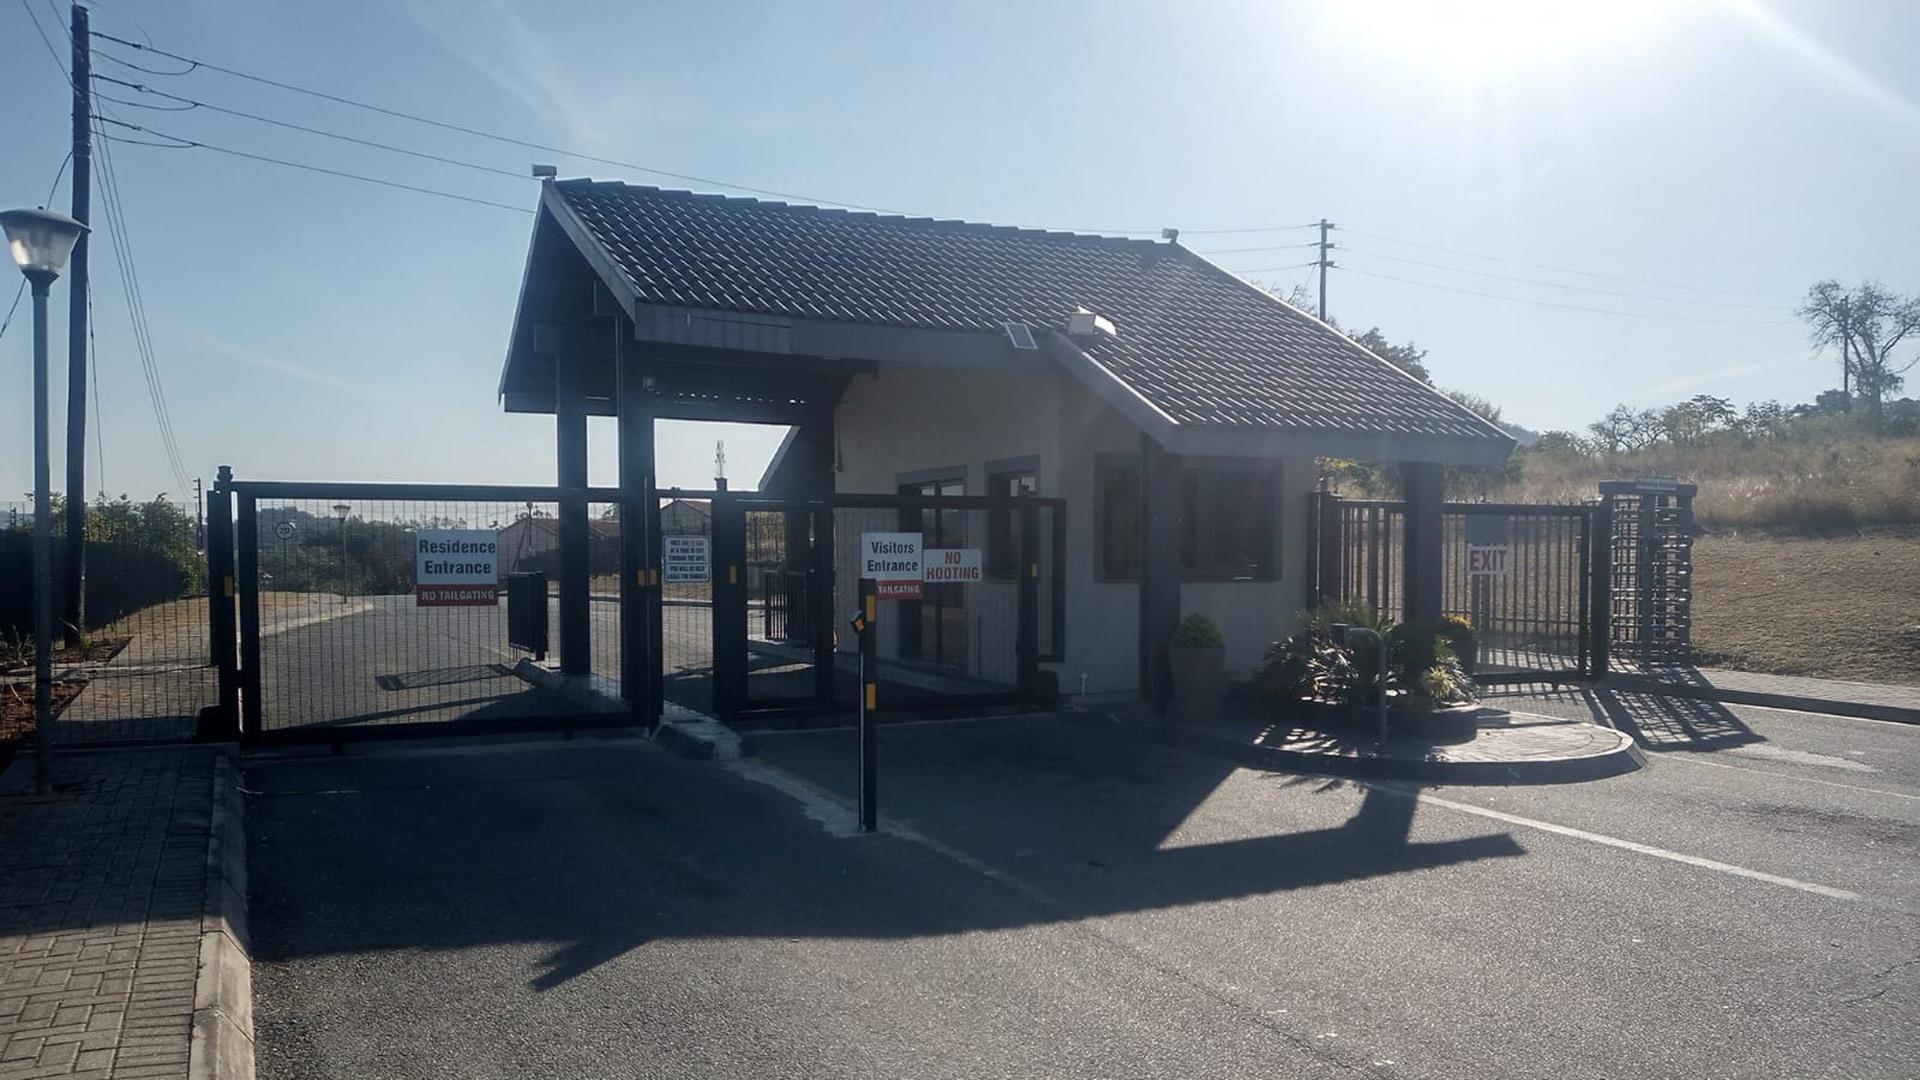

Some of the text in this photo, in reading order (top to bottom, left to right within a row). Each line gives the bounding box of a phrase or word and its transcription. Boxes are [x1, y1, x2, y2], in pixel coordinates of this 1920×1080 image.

[419, 540, 496, 554] Residence
[871, 542, 914, 554] Visitors
[945, 551, 961, 564] NO
[1470, 550, 1506, 571] EXIT
[425, 561, 491, 574] Entrance
[867, 560, 919, 572] Entrance
[927, 566, 979, 580] HOOTING
[422, 590, 494, 600] NO TAILGATING
[878, 584, 920, 594] TAILGATING
